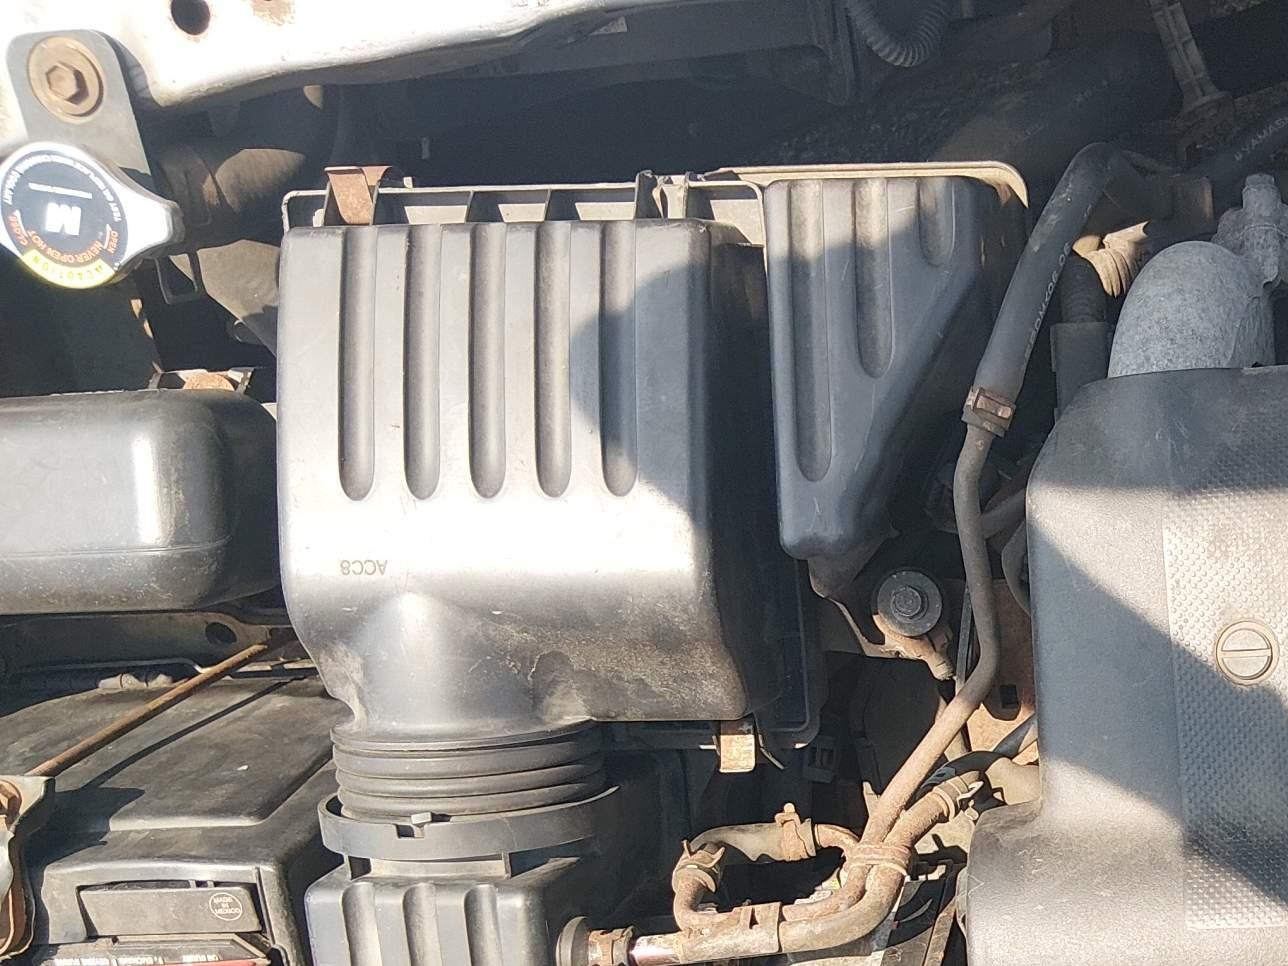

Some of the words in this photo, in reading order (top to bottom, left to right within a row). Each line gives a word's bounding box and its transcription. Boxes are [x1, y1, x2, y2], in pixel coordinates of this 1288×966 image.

[26, 229, 47, 251] HOT
[46, 246, 75, 264] OPEN
[74, 239, 103, 262] NEVER
[340, 559, 388, 576] ACC8
